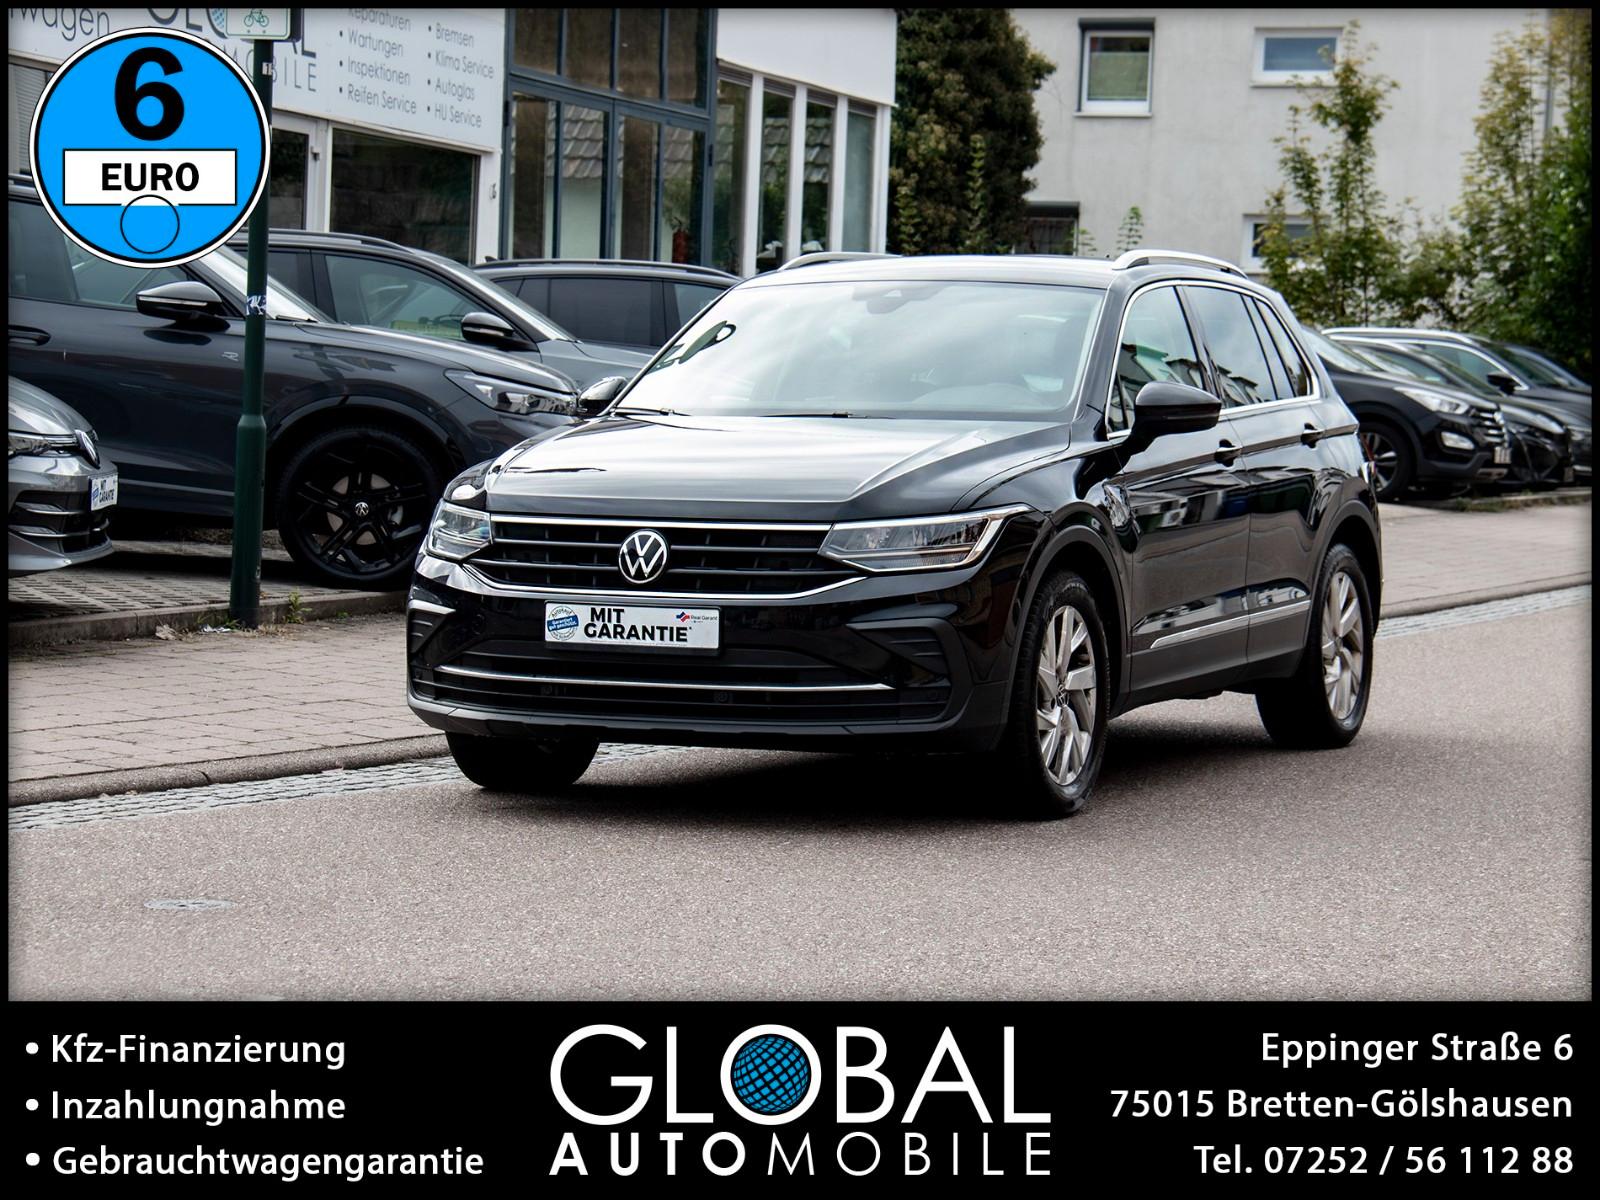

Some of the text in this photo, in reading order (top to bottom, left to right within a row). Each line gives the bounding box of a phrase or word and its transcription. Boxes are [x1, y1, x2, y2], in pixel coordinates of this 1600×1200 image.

[348, 27, 403, 58] Wartungen
[436, 22, 474, 48] Bremsen
[348, 56, 410, 86] Inspektionen
[435, 49, 495, 79] Klima Service
[348, 83, 417, 114] Reifen Service
[435, 77, 475, 102] Autoglas
[435, 103, 482, 128] HU Service
[590, 607, 625, 623] MIT
